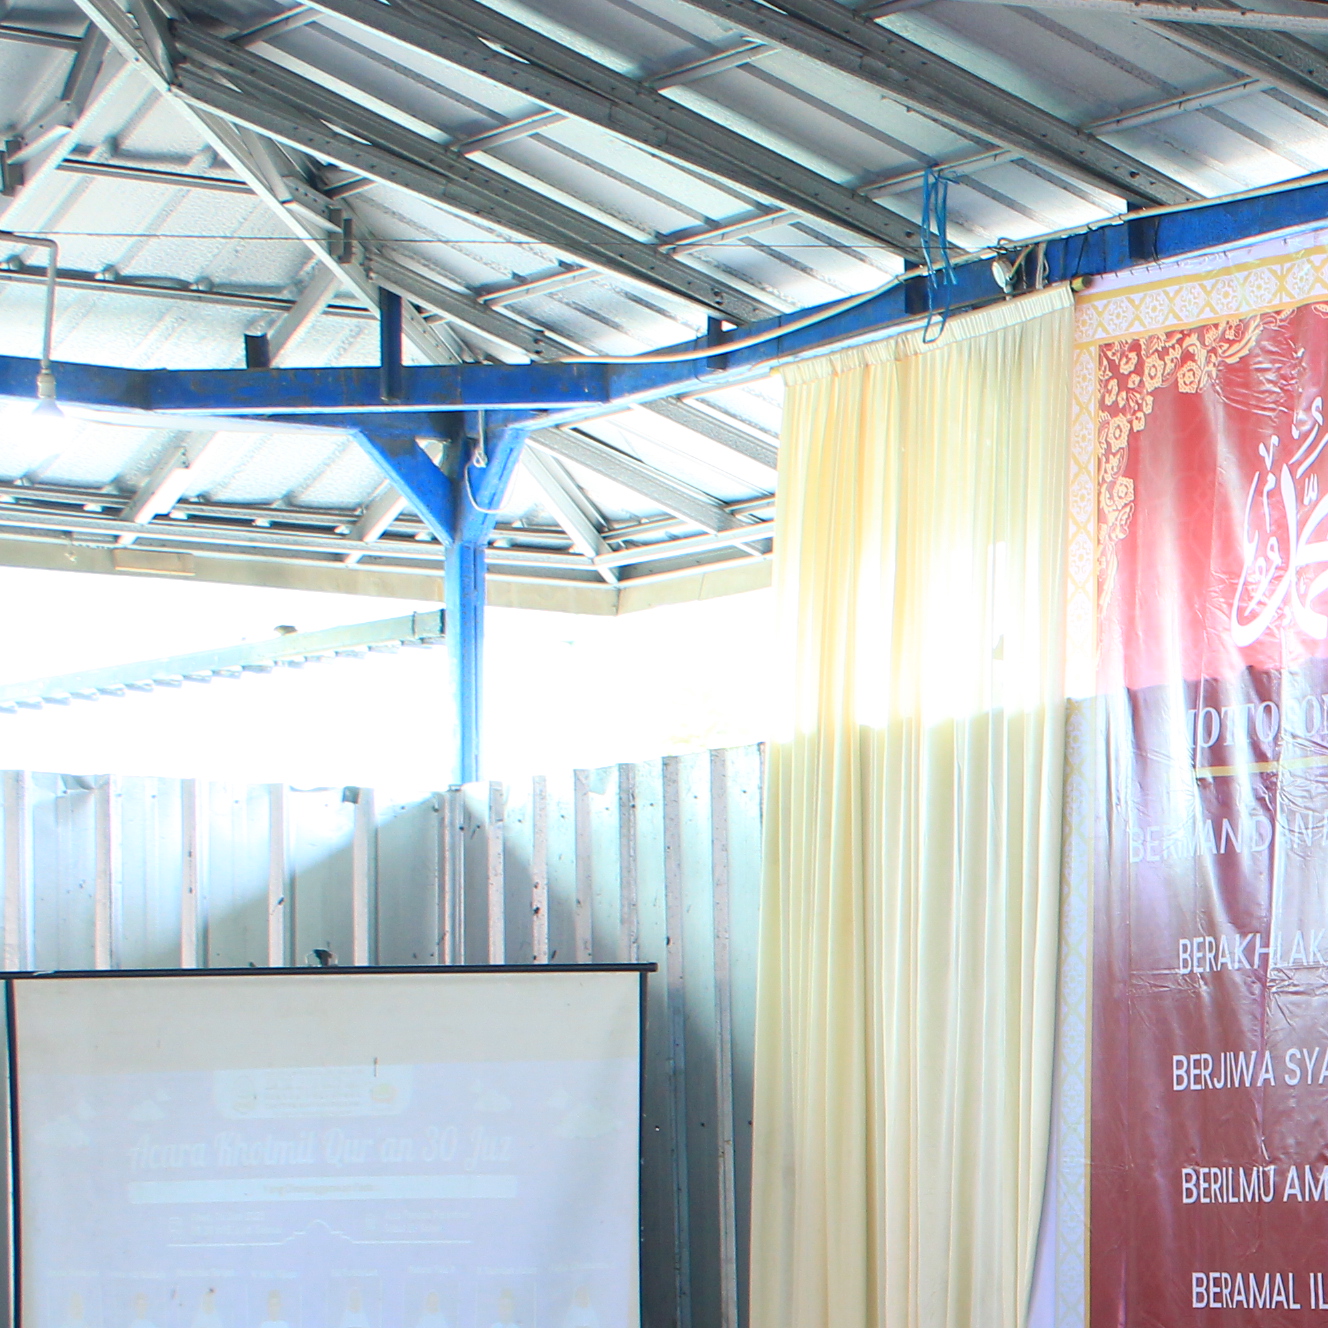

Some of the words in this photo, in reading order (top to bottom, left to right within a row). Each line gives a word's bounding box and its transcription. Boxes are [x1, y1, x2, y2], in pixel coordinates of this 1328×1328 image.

[1186, 700, 1280, 749] OTTO
[1179, 927, 1327, 975] BERAKHLAK
[1172, 1050, 1276, 1091] BERJIWA
[1181, 1165, 1275, 1204] BERILMU
[1192, 1272, 1301, 1310] BERAMAL
